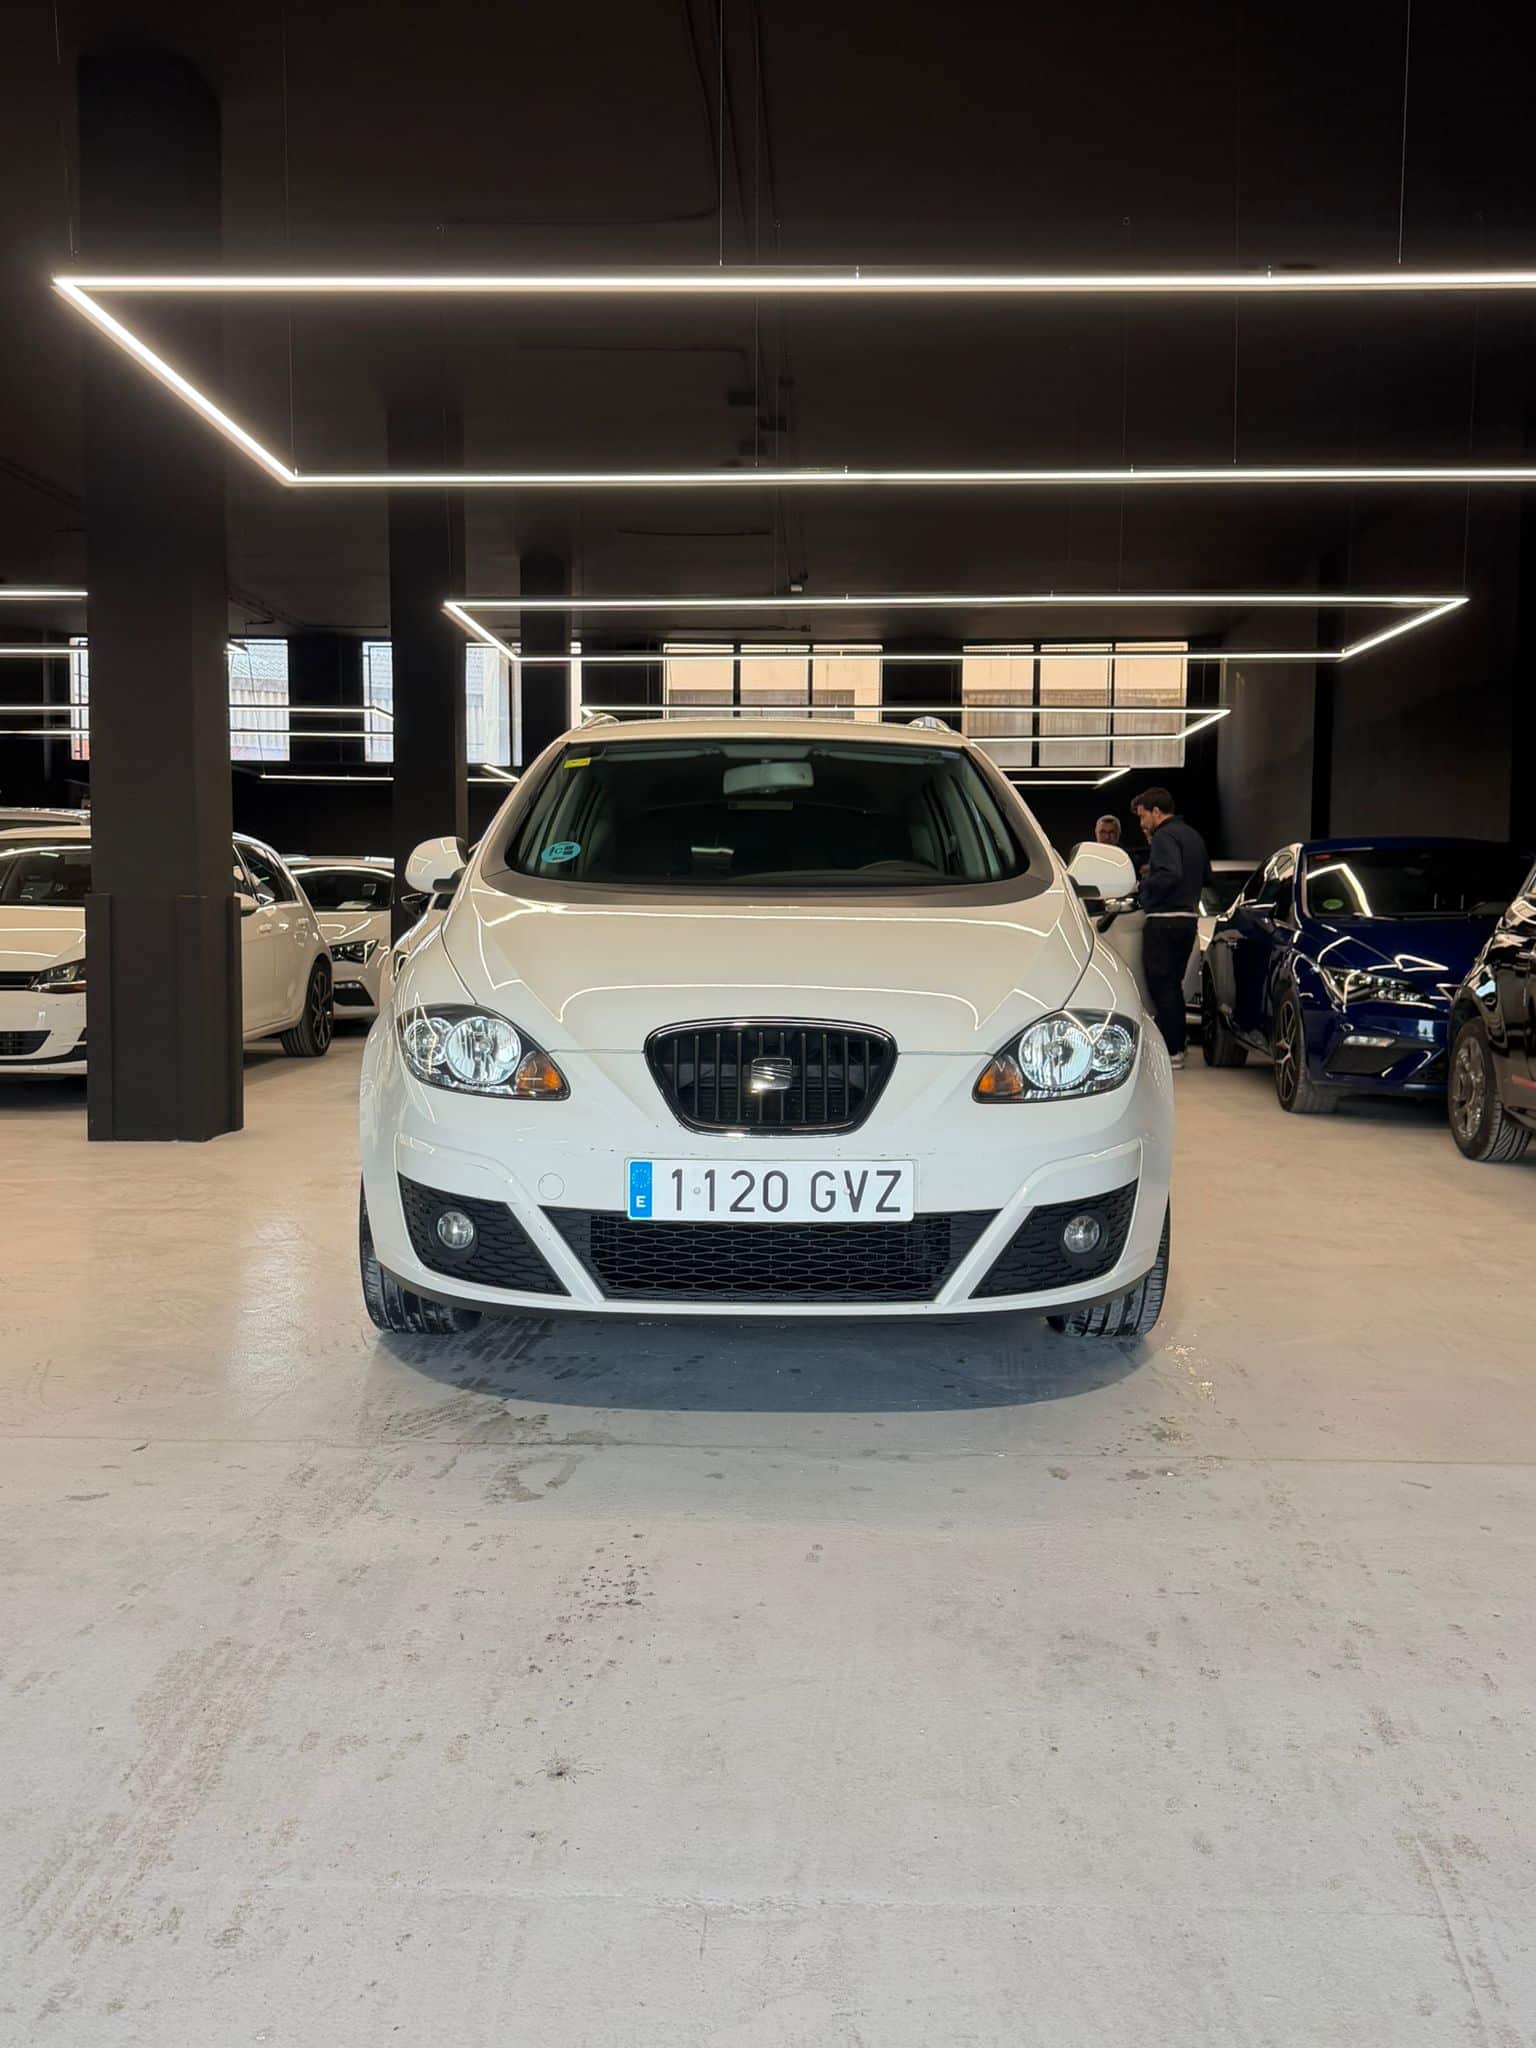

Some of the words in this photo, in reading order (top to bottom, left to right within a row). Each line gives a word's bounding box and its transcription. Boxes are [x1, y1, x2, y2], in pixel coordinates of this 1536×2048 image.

[635, 1195, 647, 1208] E
[671, 1168, 789, 1213] 1120
[810, 1169, 903, 1213] GVZ
